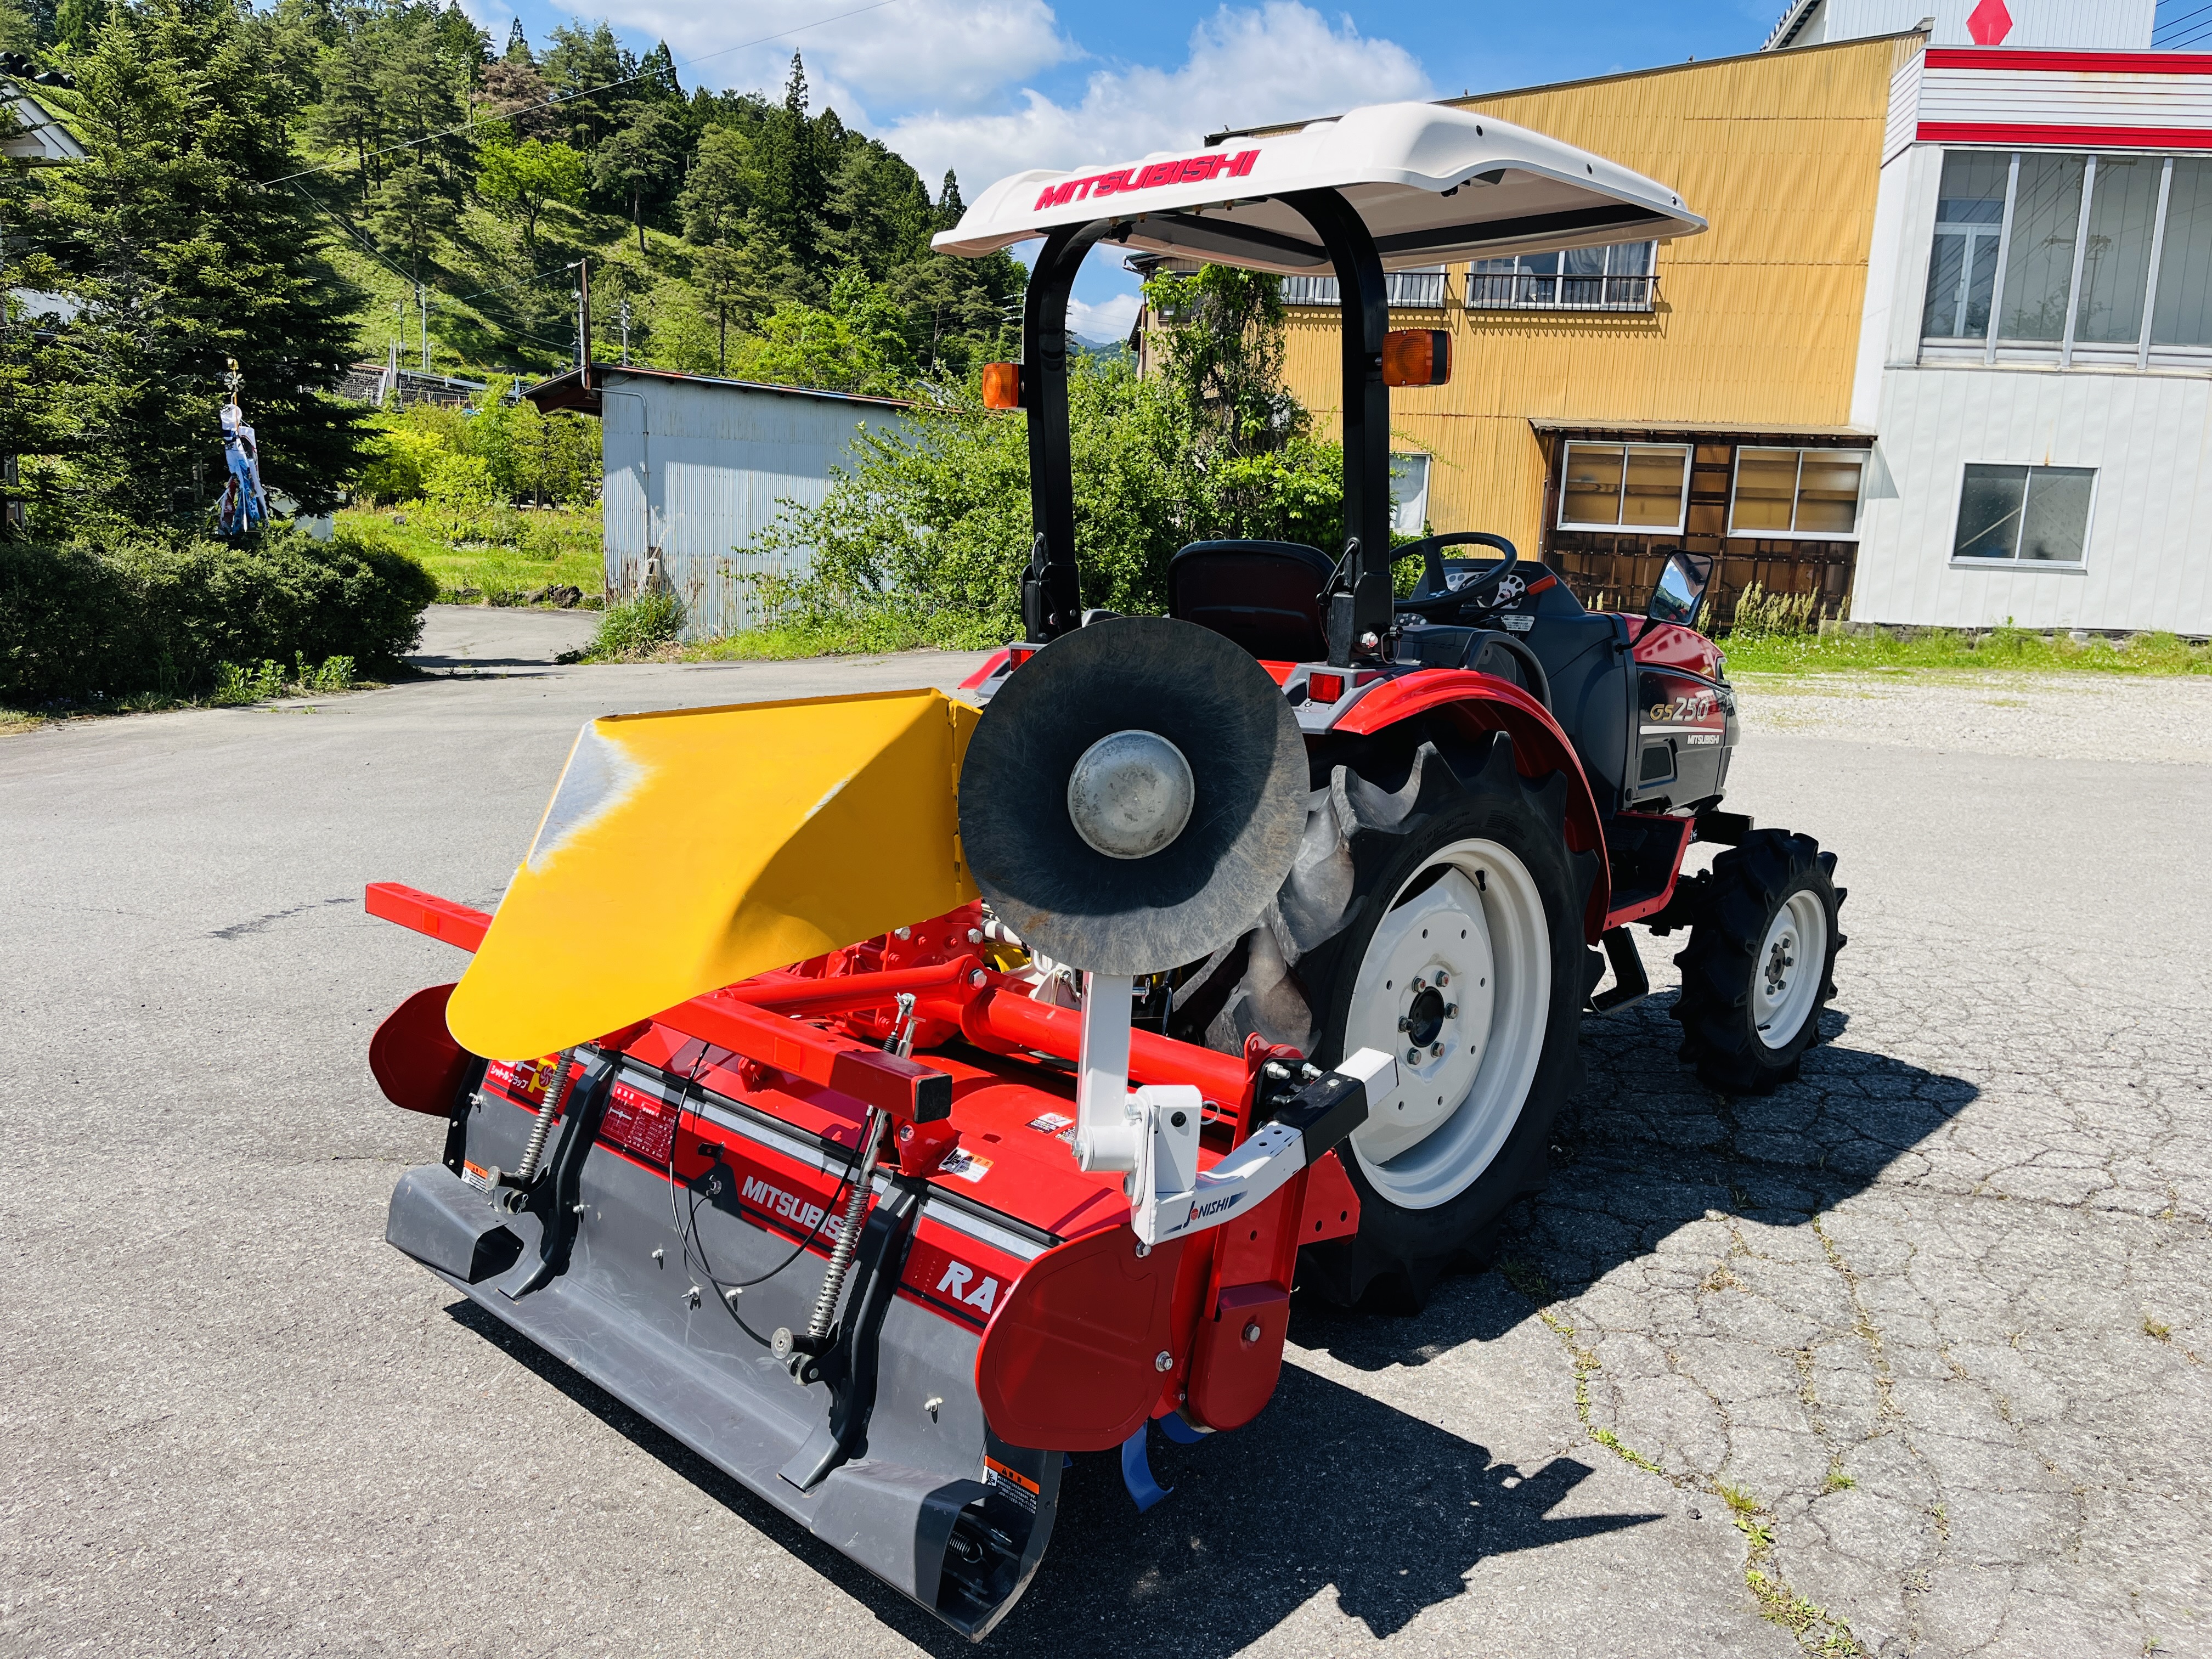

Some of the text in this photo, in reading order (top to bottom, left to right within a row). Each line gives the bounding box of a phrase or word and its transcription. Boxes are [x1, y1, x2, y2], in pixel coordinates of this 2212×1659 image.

[1034, 149, 1262, 211] MITSUBISHI
[1650, 697, 1709, 722] GS250
[1687, 735, 1720, 744] MITSUBISHI
[741, 1175, 859, 1244] MITSUBIS
[936, 1260, 1010, 1314] RA
